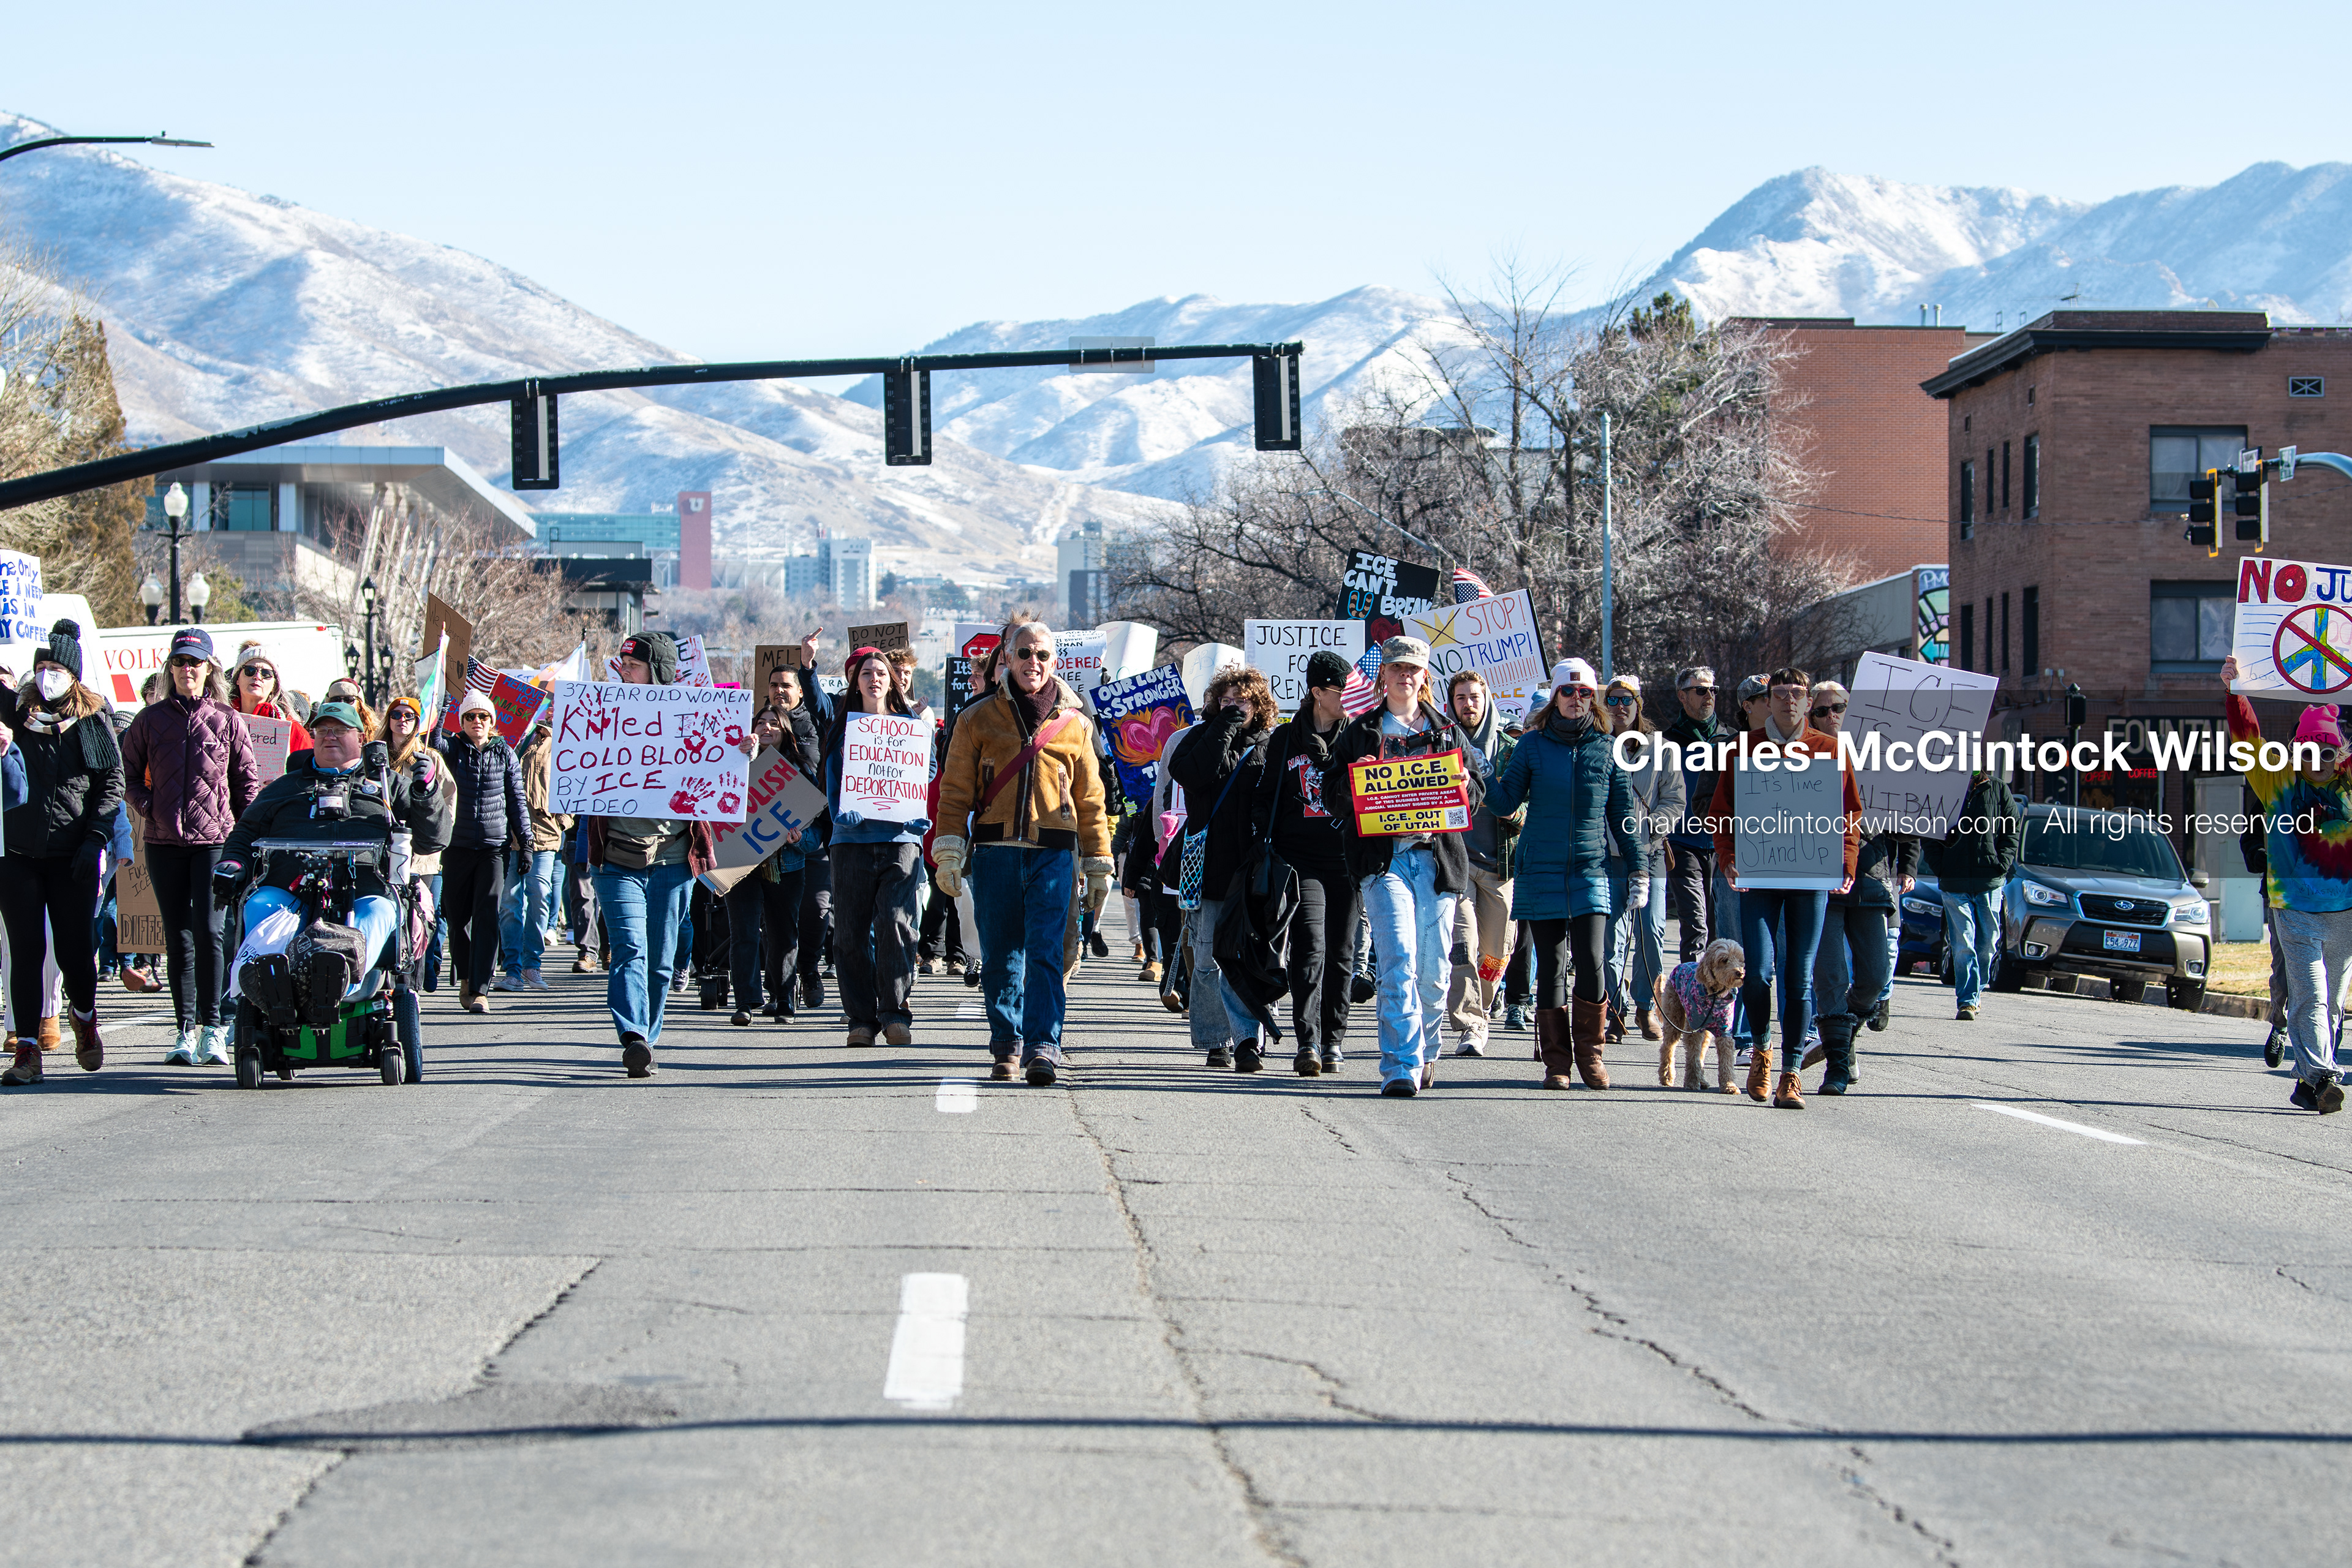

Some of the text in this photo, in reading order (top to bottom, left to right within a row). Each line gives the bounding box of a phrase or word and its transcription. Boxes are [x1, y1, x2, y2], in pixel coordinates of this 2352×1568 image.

[18, 559, 39, 584] Only
[1355, 552, 1398, 579] ICE
[24, 583, 43, 601] NEED
[1343, 569, 1398, 597] CAN'T
[2237, 560, 2307, 604] NO
[429, 598, 440, 627] We
[1466, 595, 1527, 636] STOP!
[16, 620, 49, 643] COFFEE
[852, 624, 905, 642] DO NOT
[1256, 625, 1347, 649] JUSTICE
[853, 636, 905, 651] REJECT
[1461, 631, 1534, 668] TRUMP!
[1289, 654, 1313, 673] FO
[503, 676, 546, 701] REMOVE
[563, 682, 750, 704] 37 YEAR OLD WOMEN
[1098, 677, 1136, 701] OUR
[1136, 665, 1178, 687] LOVE
[516, 693, 539, 709] ICE!
[1111, 677, 1186, 718] STRONGER
[1865, 660, 1978, 733] ICE
[858, 717, 924, 737] SCHOOL
[875, 735, 907, 747] is for
[556, 745, 725, 772] COLD BLOOD
[850, 744, 924, 767] EDUCATION
[1365, 760, 1448, 780] NO I.C.E.
[2084, 771, 2113, 783] OPEN
[2128, 767, 2158, 779] COFFEE
[557, 769, 666, 796] BY ICE
[846, 775, 927, 801] DEPORTATION
[1364, 775, 1449, 793] ALLOWED
[1744, 771, 1823, 796] It's Time
[559, 799, 638, 815] VIDEO
[1379, 810, 1442, 823] I.C.E. OUT
[1772, 802, 1792, 818] to
[742, 800, 802, 855] ICE
[1405, 820, 1441, 830] UTAH
[132, 875, 152, 897] ICE
[121, 913, 166, 946] DIFFE
[2106, 937, 2138, 949] E54 9ZZ
